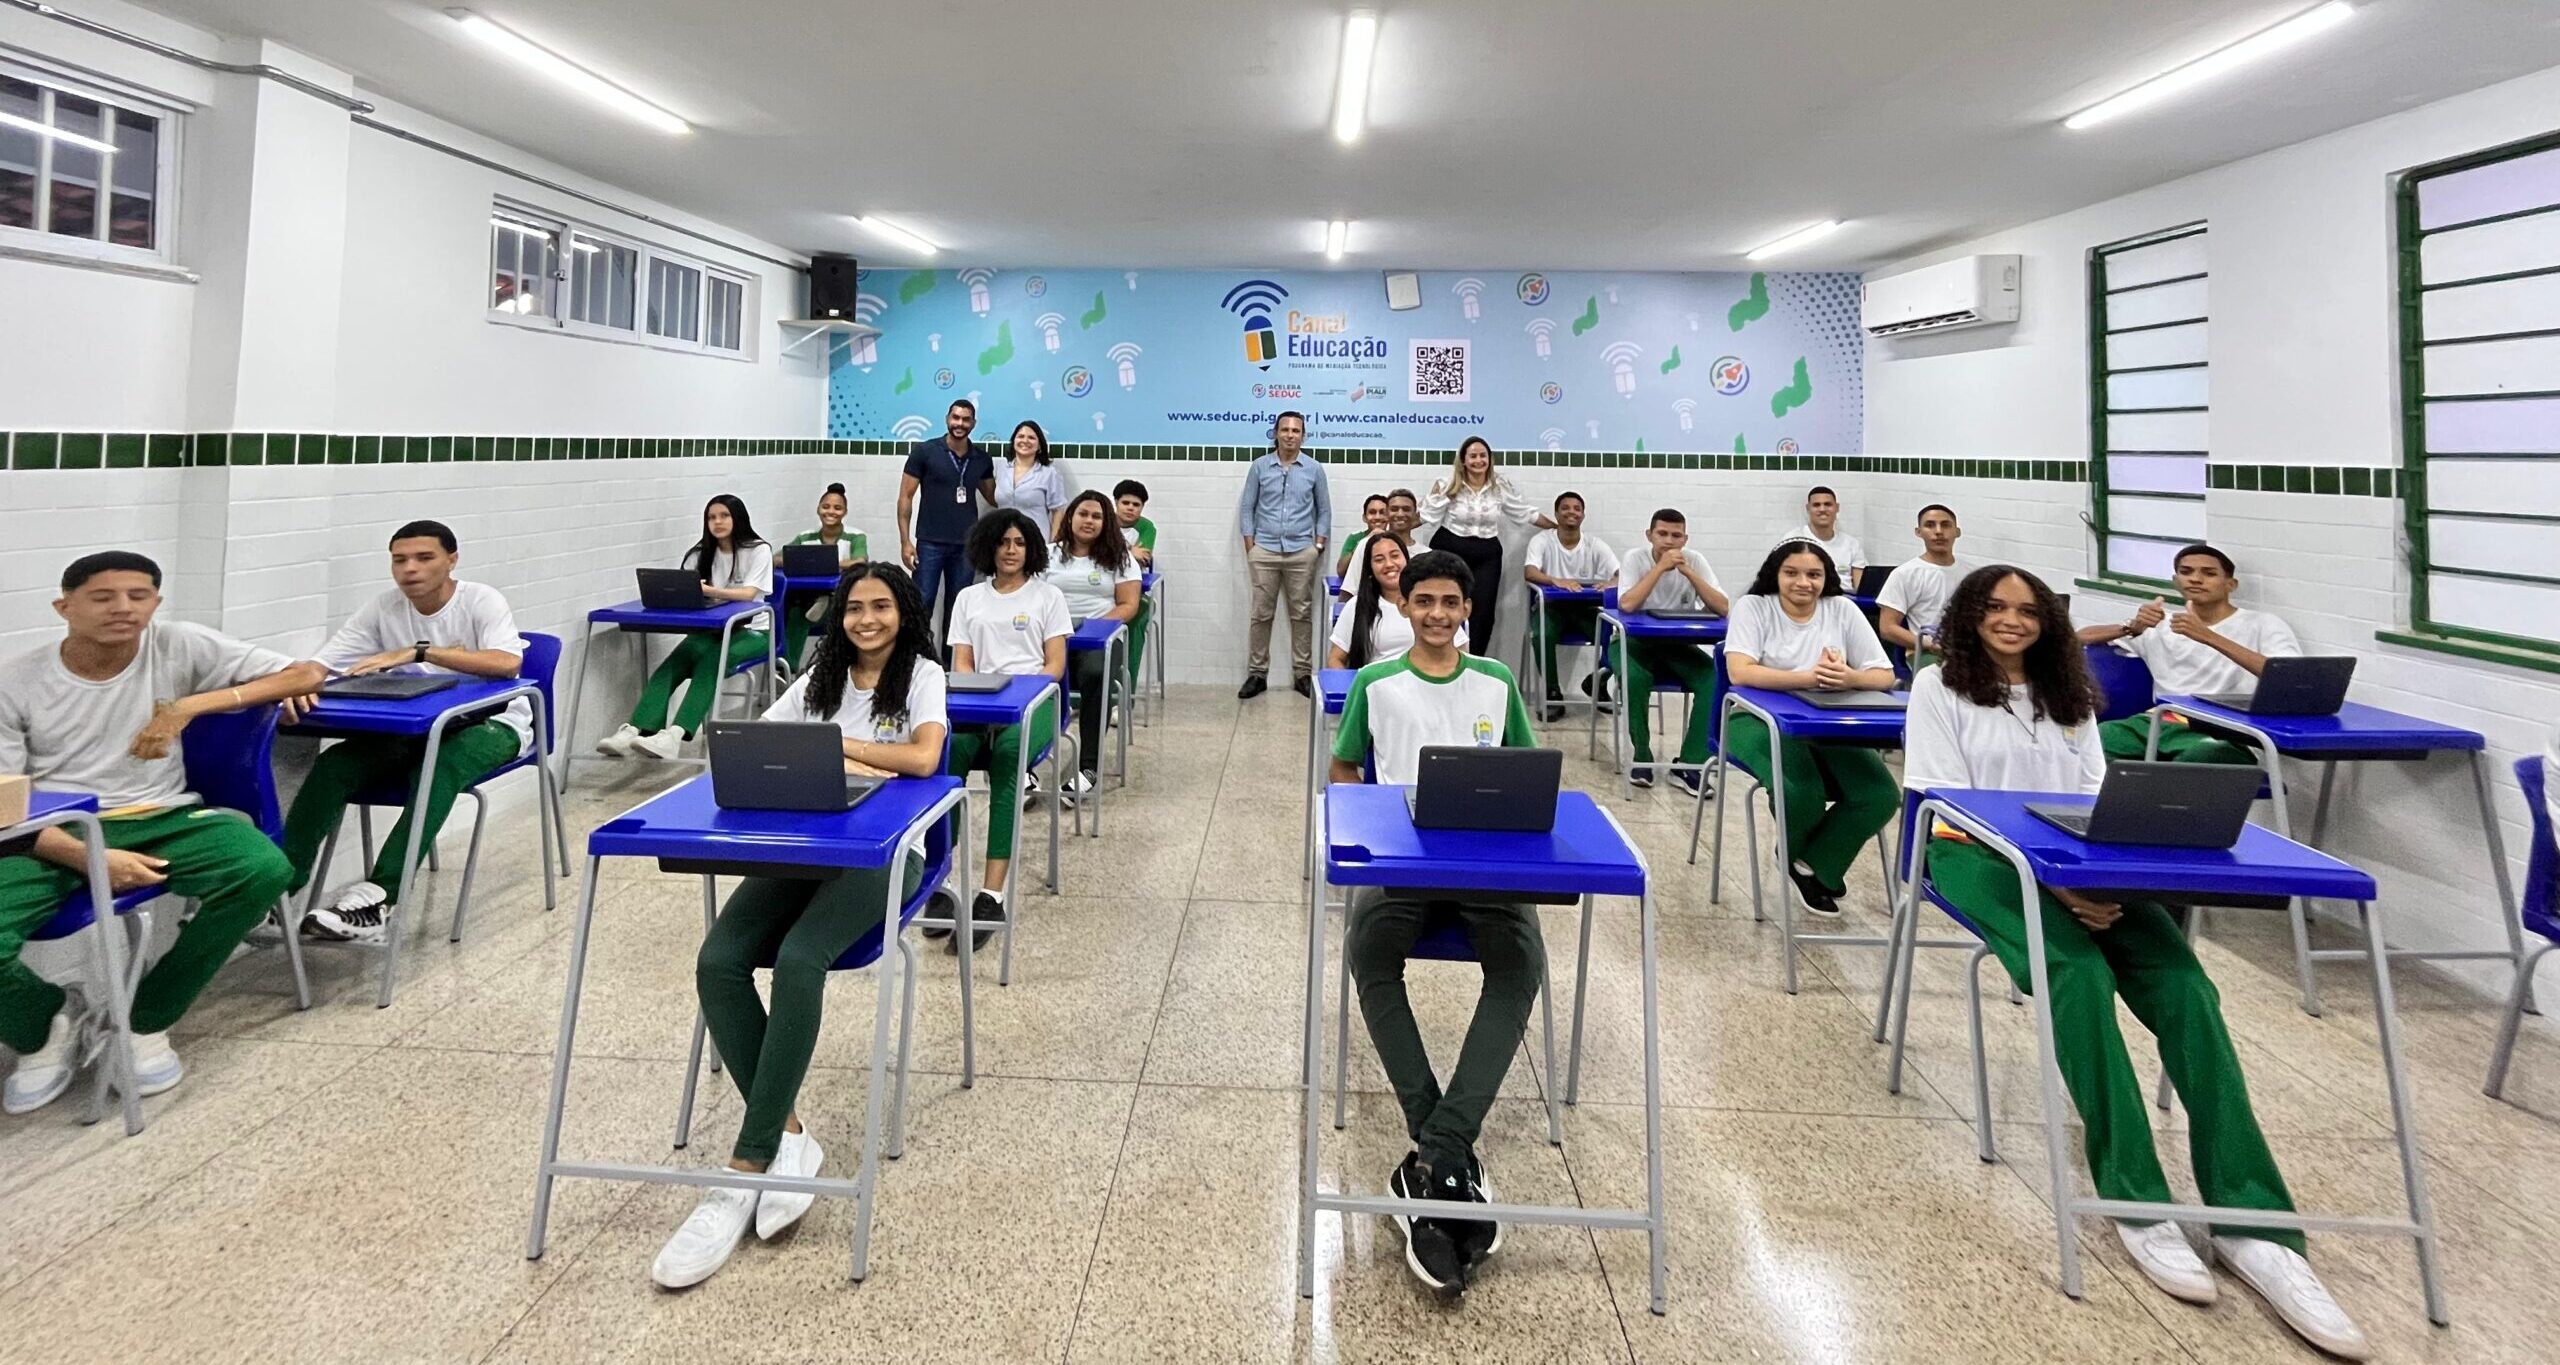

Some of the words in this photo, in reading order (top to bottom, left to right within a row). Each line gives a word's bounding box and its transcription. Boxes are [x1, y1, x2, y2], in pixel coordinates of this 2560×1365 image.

[1288, 310, 1346, 333] Canal
[1288, 334, 1387, 362] Educação
[1268, 390, 1302, 398] SEDUC
[1322, 412, 1485, 424] www.canaleducacao.tv
